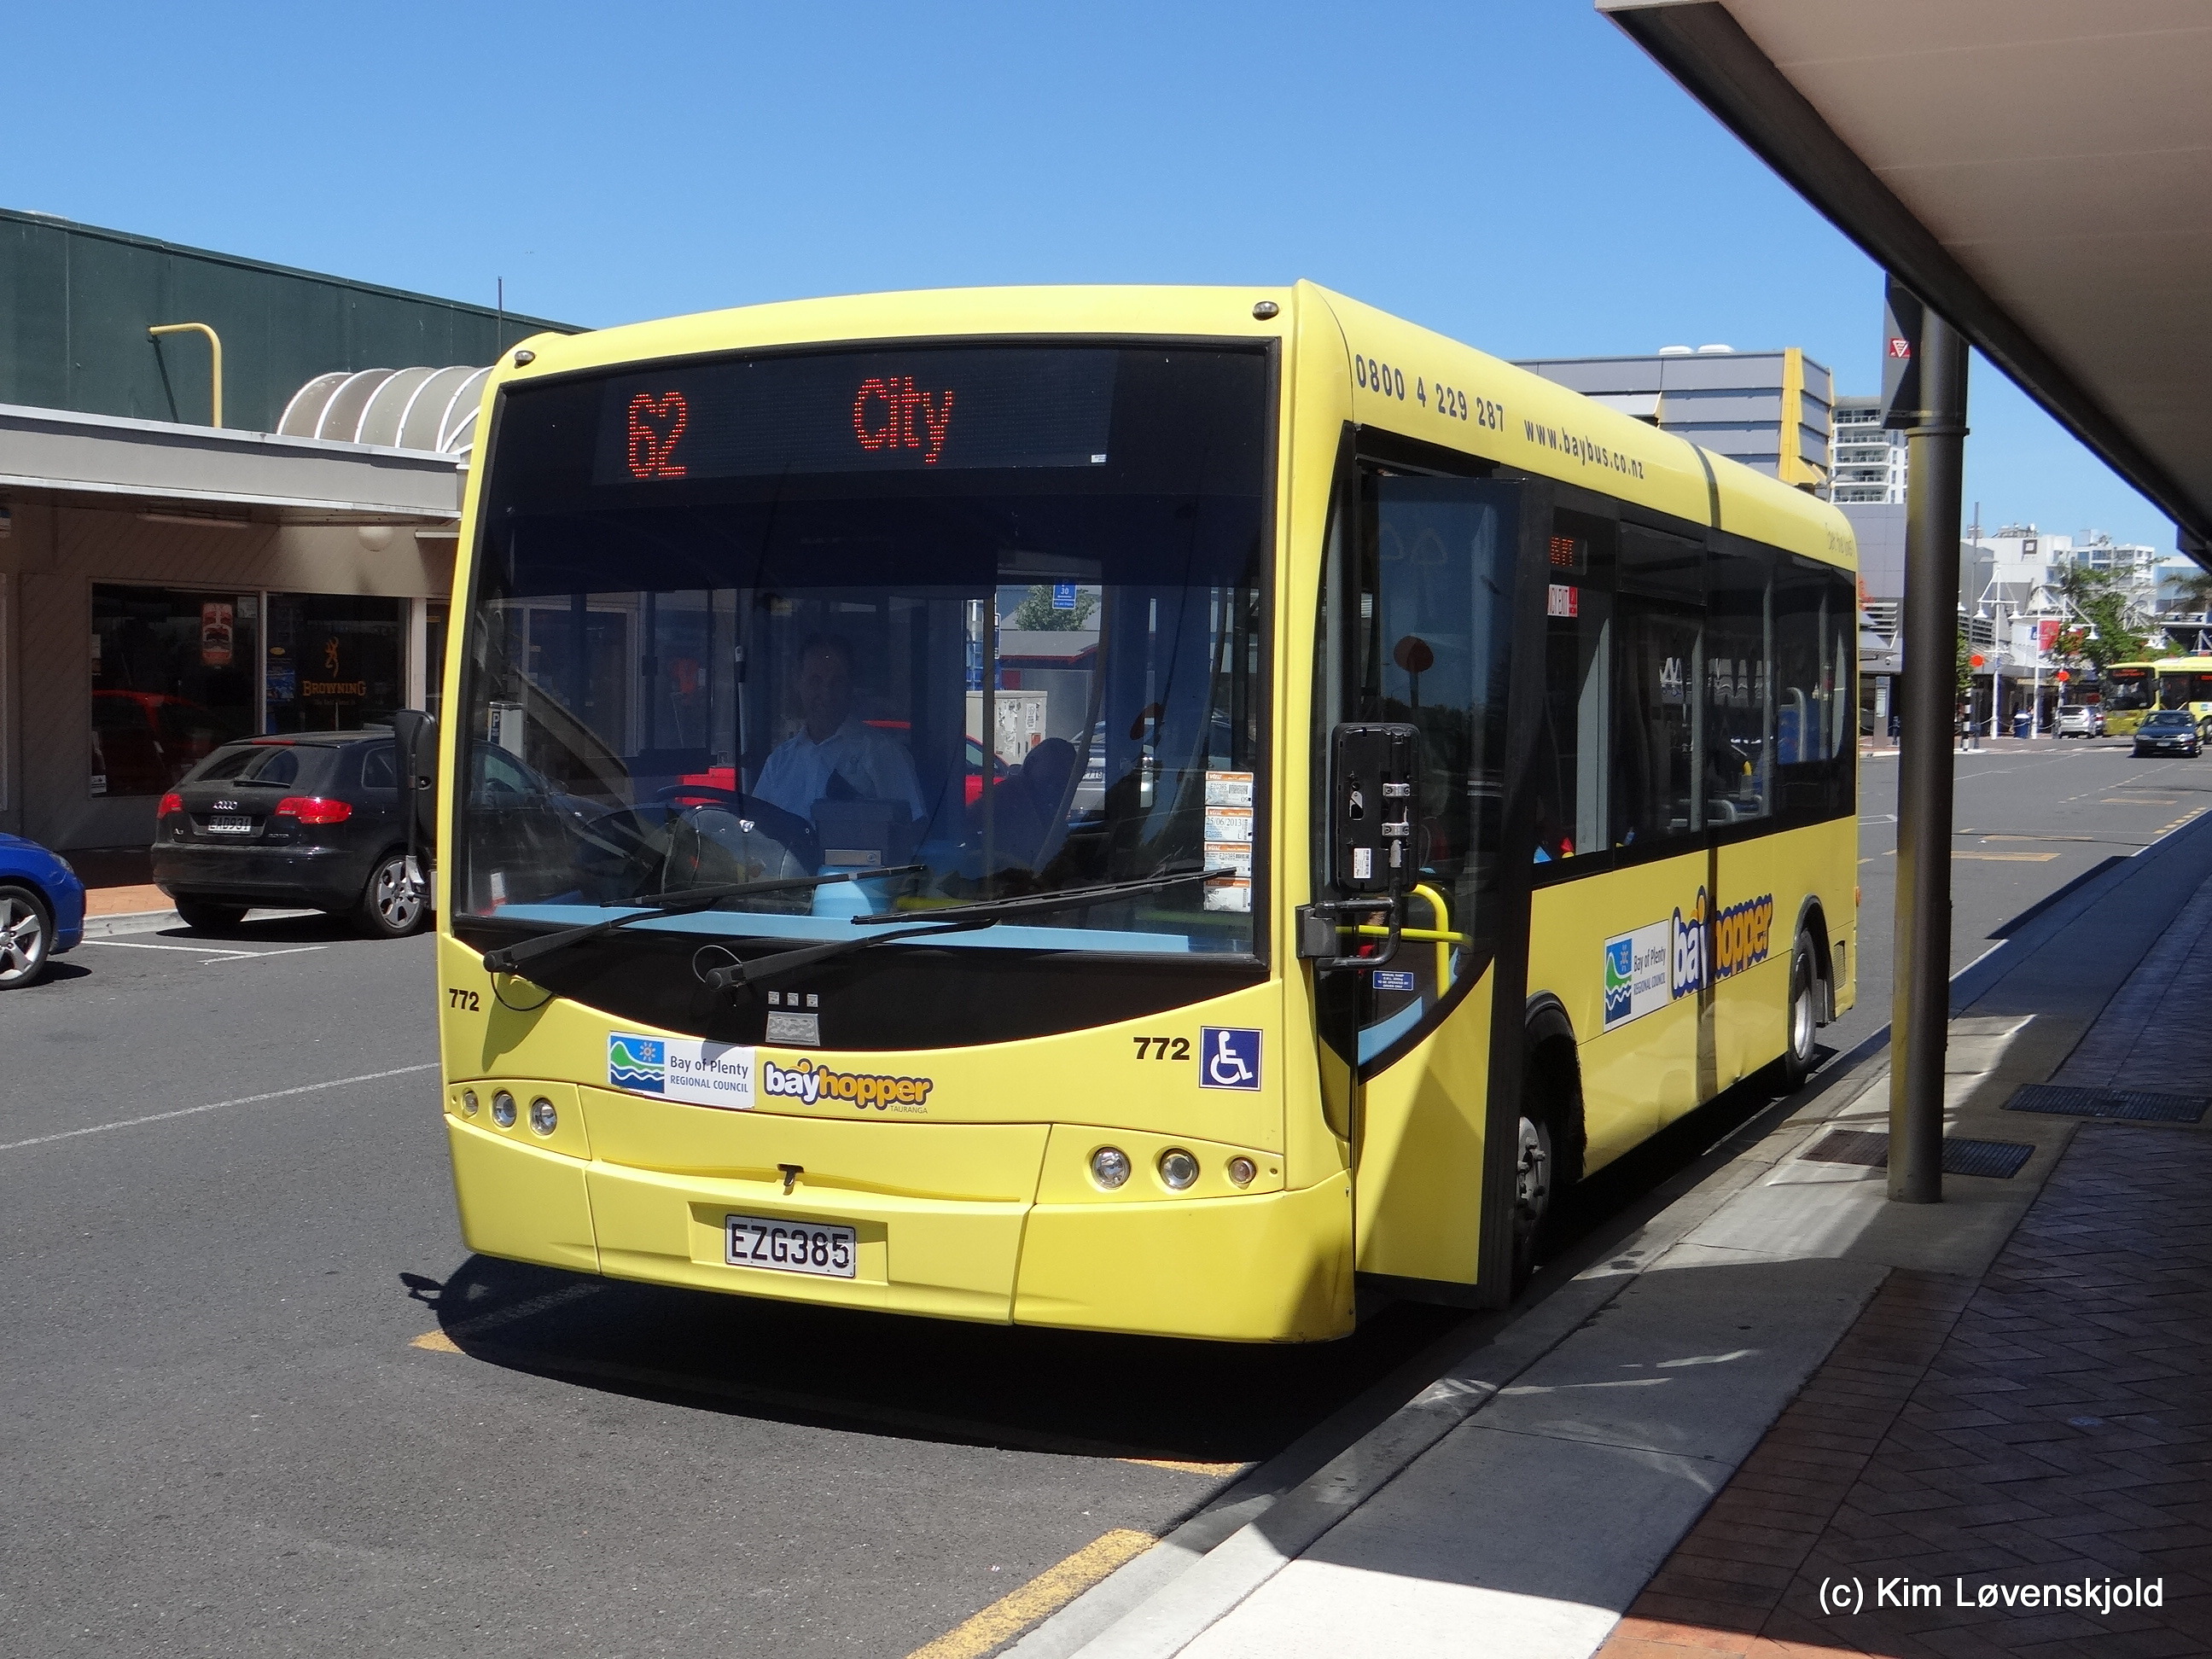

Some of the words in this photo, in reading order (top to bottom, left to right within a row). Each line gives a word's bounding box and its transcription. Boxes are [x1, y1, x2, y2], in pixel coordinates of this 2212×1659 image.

[1355, 353, 1405, 401] 0800
[1417, 376, 1426, 408] 4
[1435, 383, 1468, 422] 229
[1476, 397, 1504, 433] 287
[629, 391, 687, 478] 62
[853, 375, 953, 463] City
[1523, 419, 1644, 480] www.baybus.co.nz
[302, 679, 367, 697] BROWNING
[492, 713, 500, 728] P
[1205, 817, 1243, 827] 25/06/2013
[1633, 955, 1644, 975] Bay
[1644, 952, 1650, 969] of
[1650, 947, 1667, 968] Plenty
[1633, 975, 1651, 996] REGIONAL
[1651, 971, 1666, 989] COUNCIL
[448, 987, 480, 1013] 772
[1132, 1037, 1190, 1061] 772
[670, 1056, 692, 1074] Bay
[694, 1057, 707, 1072] of
[710, 1062, 749, 1079] Plenty
[670, 1075, 711, 1090] REGIONAL
[713, 1079, 749, 1093] COUNCIL
[765, 1061, 933, 1109] bayhopper
[890, 1104, 928, 1115] TAURANGA
[731, 1223, 850, 1269] EZG385
